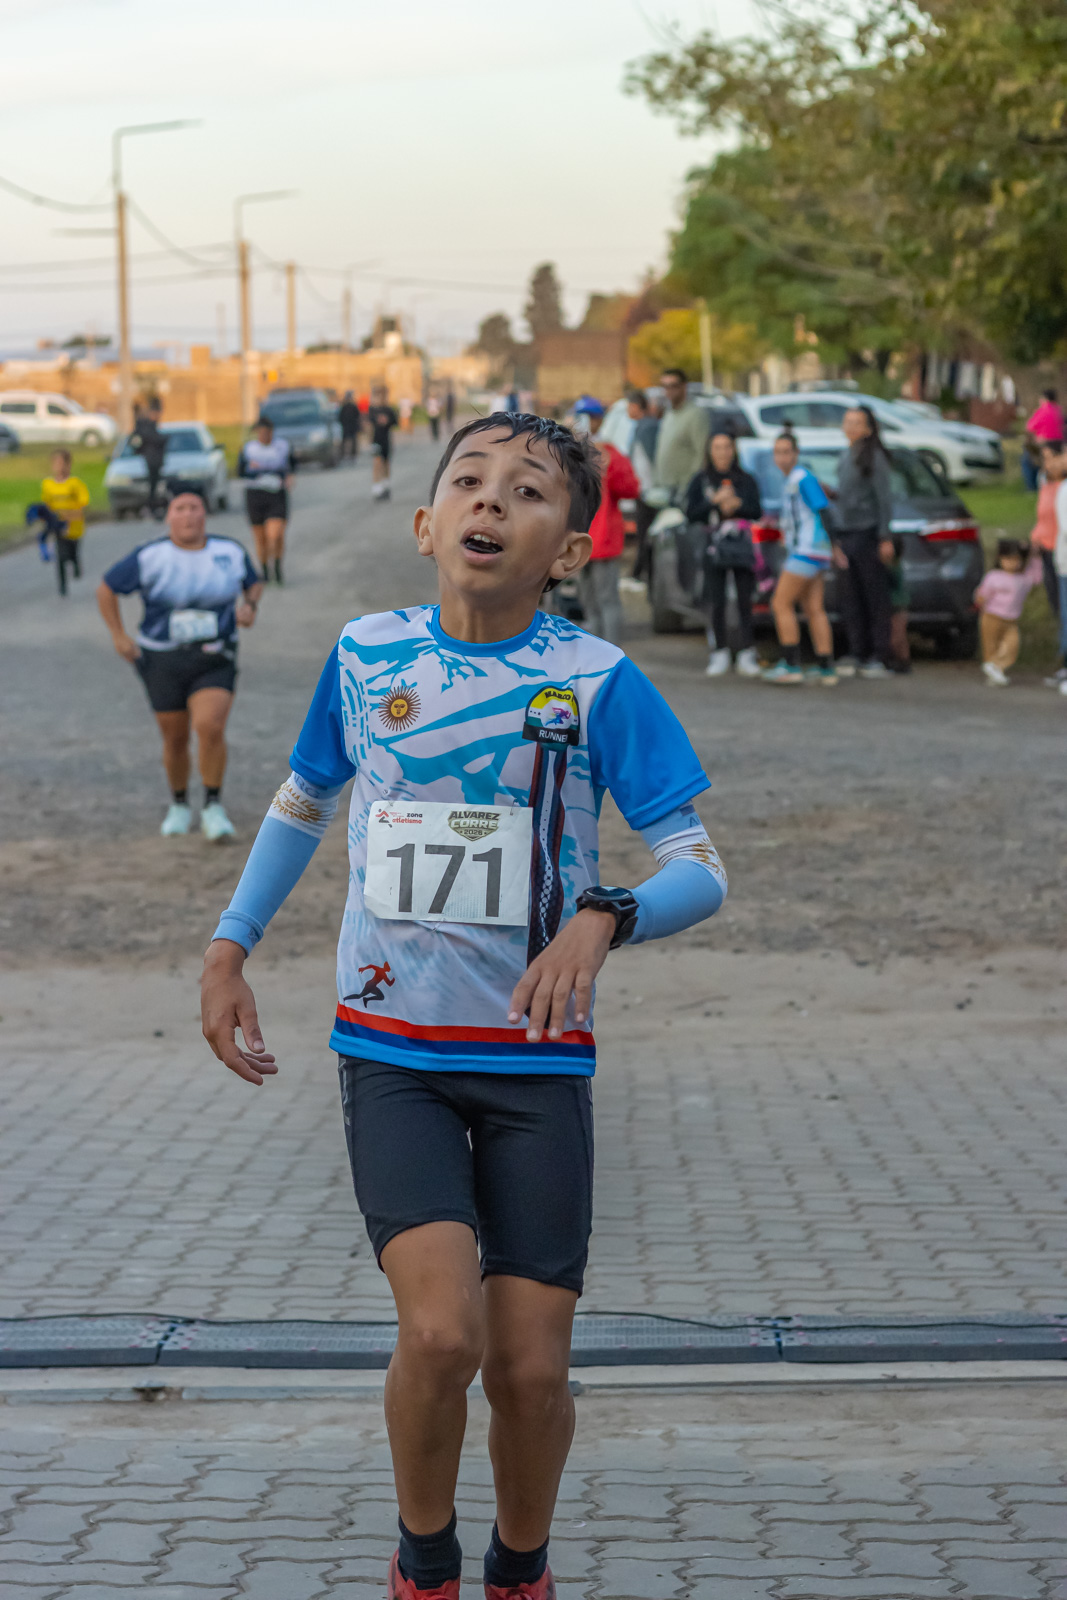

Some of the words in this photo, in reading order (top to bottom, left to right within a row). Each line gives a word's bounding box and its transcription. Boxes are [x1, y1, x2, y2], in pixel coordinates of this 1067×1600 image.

[449, 811, 501, 820] ALVAREZ
[450, 819, 498, 829] CORRE
[386, 843, 503, 918] 171
